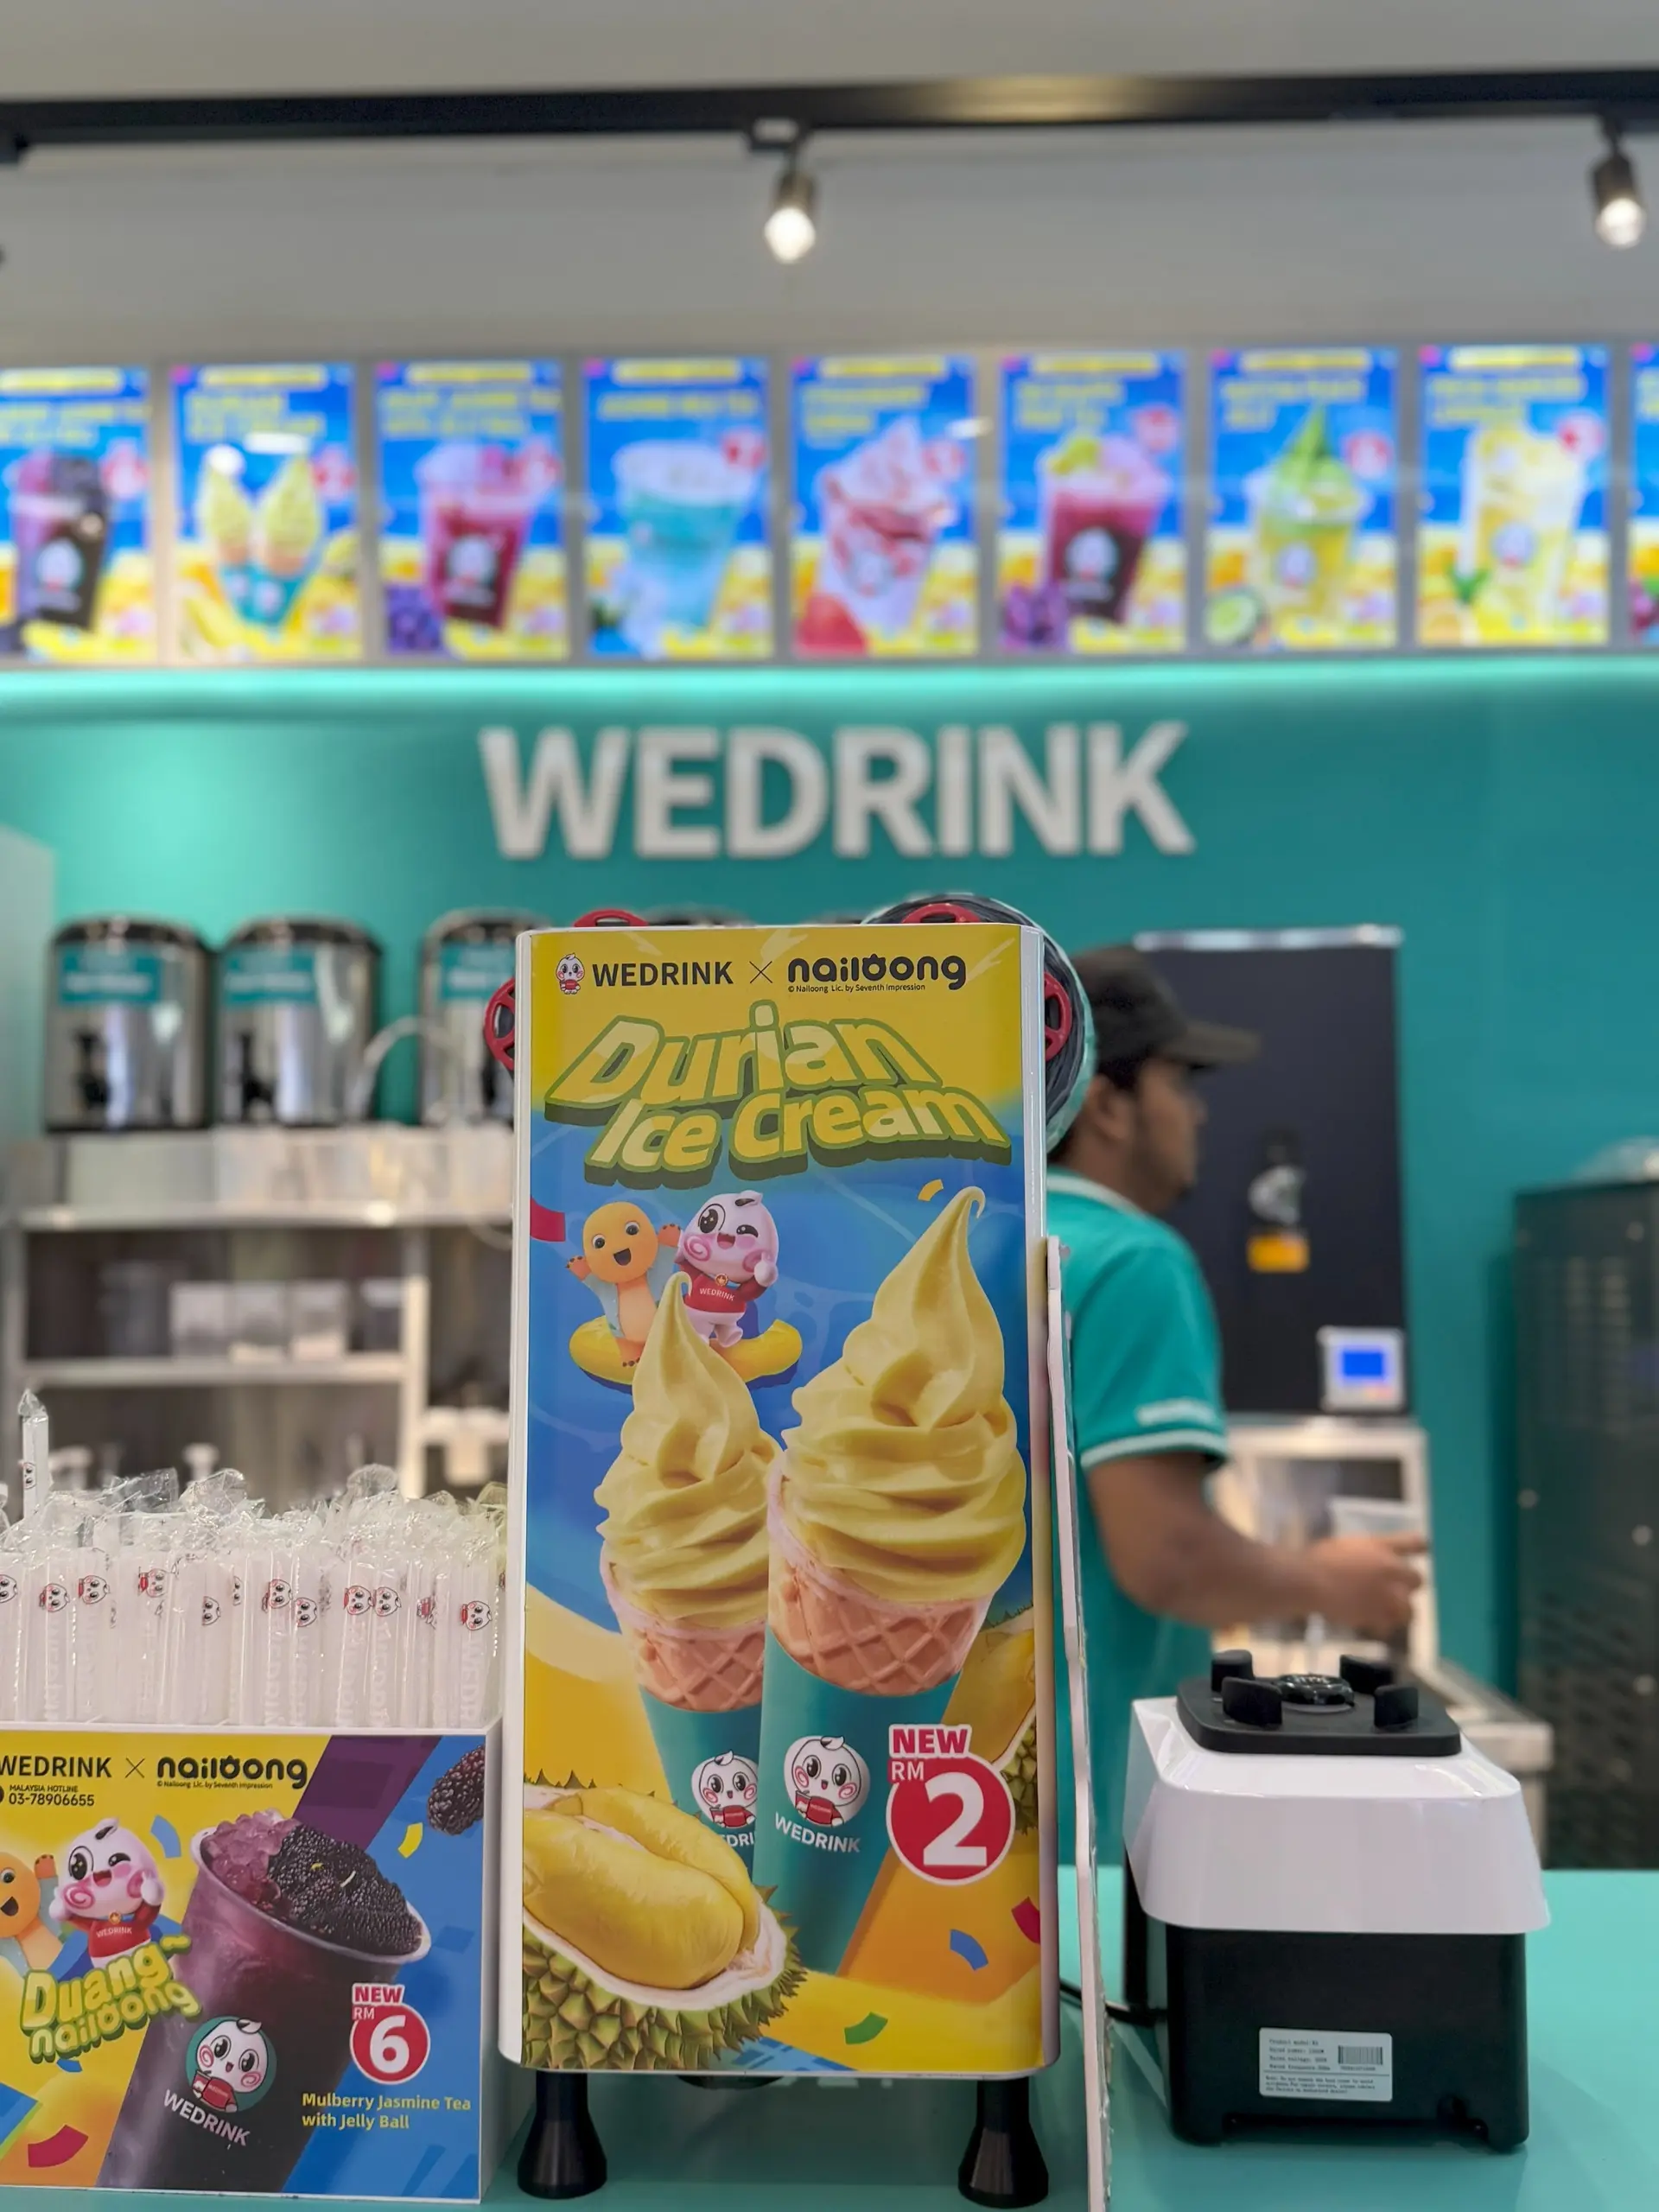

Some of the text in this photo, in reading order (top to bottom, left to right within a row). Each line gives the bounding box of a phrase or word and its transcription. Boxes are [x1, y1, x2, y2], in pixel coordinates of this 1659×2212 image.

[477, 721, 1196, 859] WEDRINK
[592, 961, 734, 987] WEDRINK
[796, 984, 829, 994] Nailoong
[845, 984, 854, 993] by
[855, 983, 885, 992] Seventh
[886, 982, 925, 993] Impression
[545, 1000, 942, 1110] Durian
[585, 1085, 1011, 1178] Ice Cream
[699, 1287, 734, 1301] WEDRINK
[892, 1728, 969, 1754] NEW
[892, 1760, 925, 1781] RM
[9, 1792, 95, 1807] 03-78906655
[922, 1770, 988, 1867] 2
[775, 1811, 861, 1853] WEDRINK
[354, 1985, 404, 2004] NEW
[353, 2006, 375, 2020] RM
[369, 2014, 410, 2074] 6
[302, 2092, 471, 2111] Mulberry Jasmine Tea
[163, 2088, 251, 2146] WEDRINK
[302, 2113, 410, 2131] with Jelly Ball
